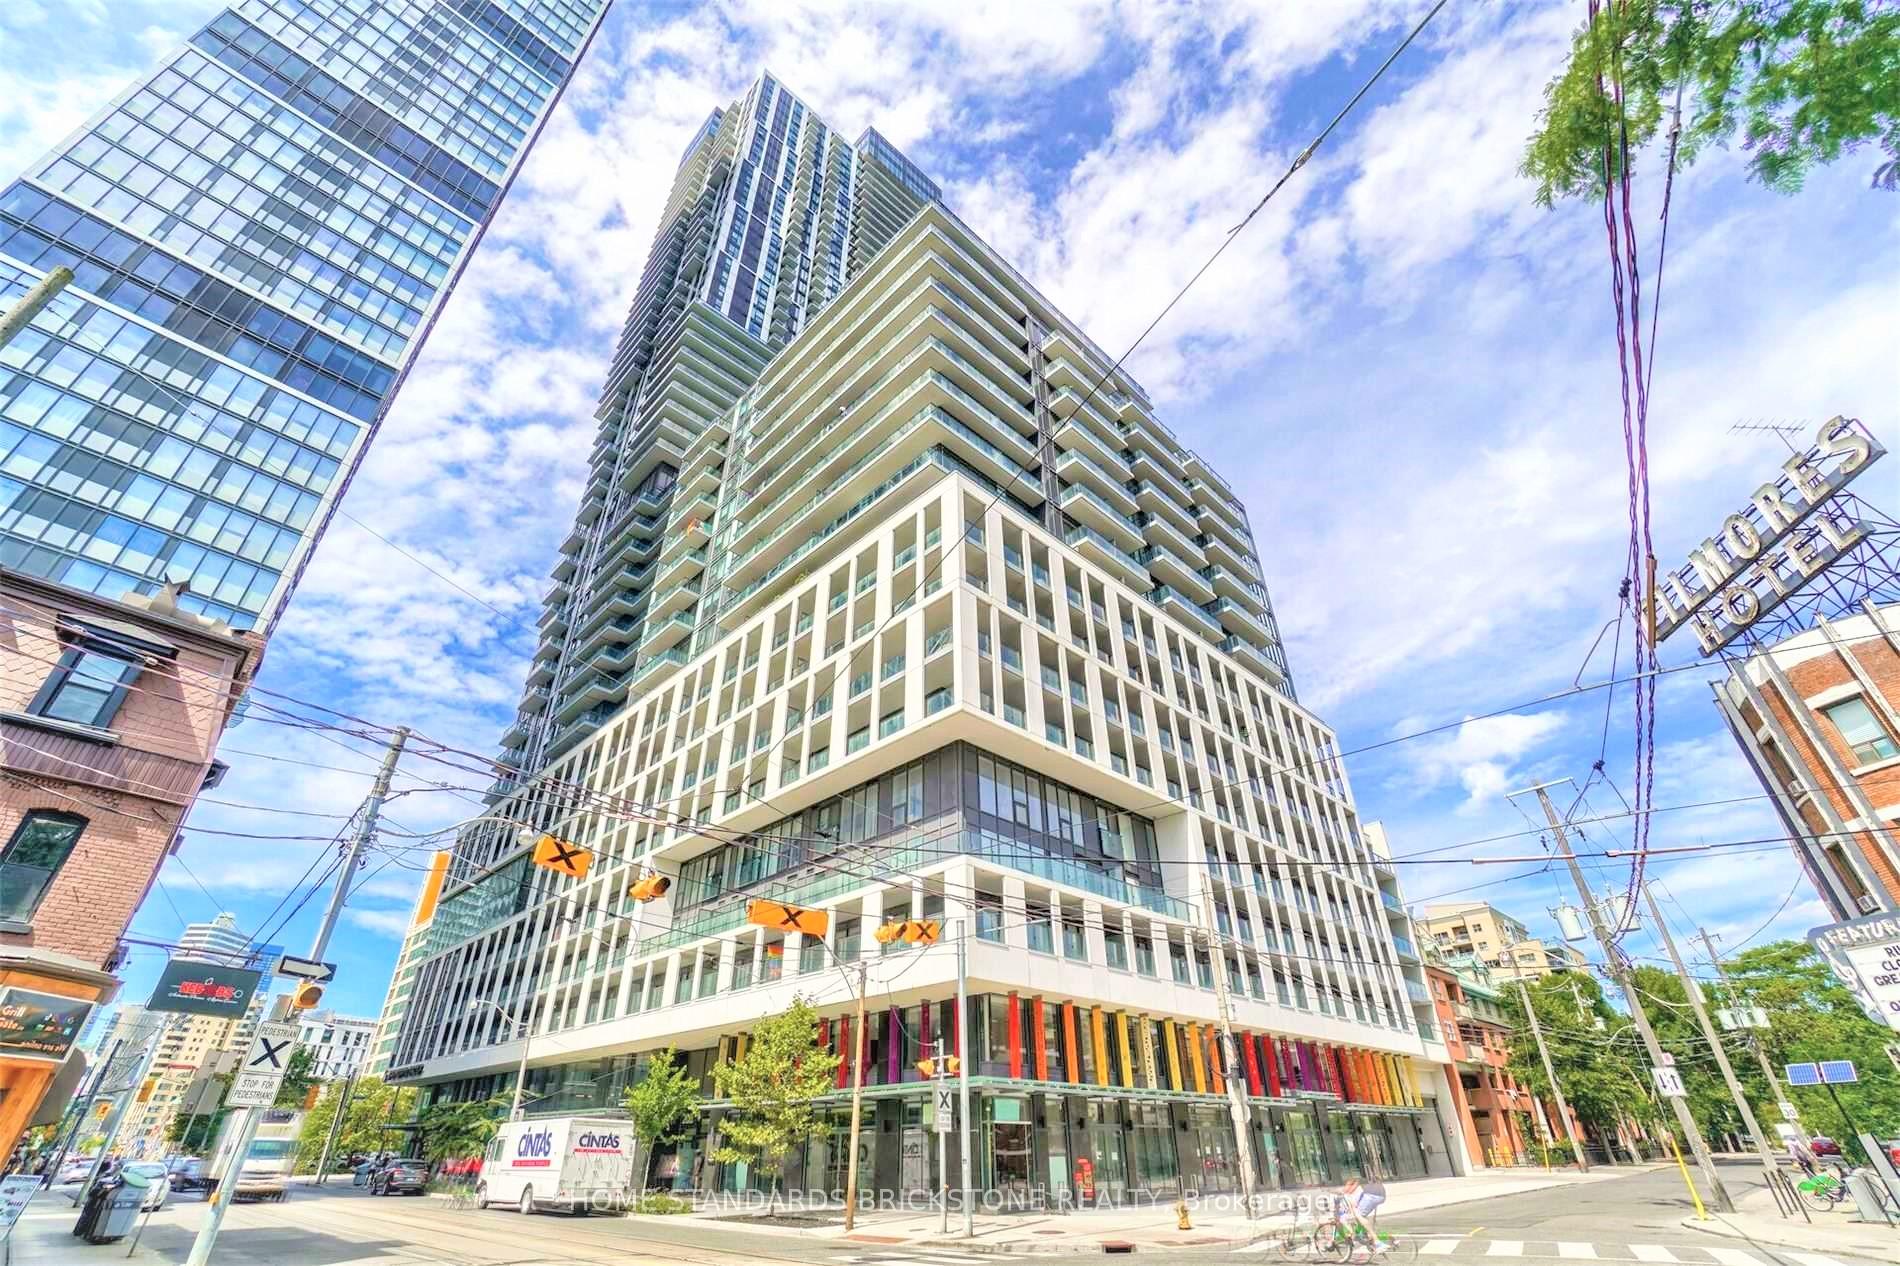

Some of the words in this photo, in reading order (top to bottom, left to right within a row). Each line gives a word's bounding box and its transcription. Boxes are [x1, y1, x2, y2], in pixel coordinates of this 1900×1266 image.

[1641, 415, 1871, 640] ILMORES
[1691, 514, 1862, 653] HOTEL
[1824, 917, 1900, 944] FEATUR
[261, 1026, 297, 1039] PEDESTRIAN
[233, 1089, 274, 1101] PEDESTRIANS
[242, 1079, 259, 1088] STOP
[262, 1080, 275, 1090] FOR
[518, 1125, 552, 1157] CINTAS
[579, 1131, 619, 1148] CINTAS
